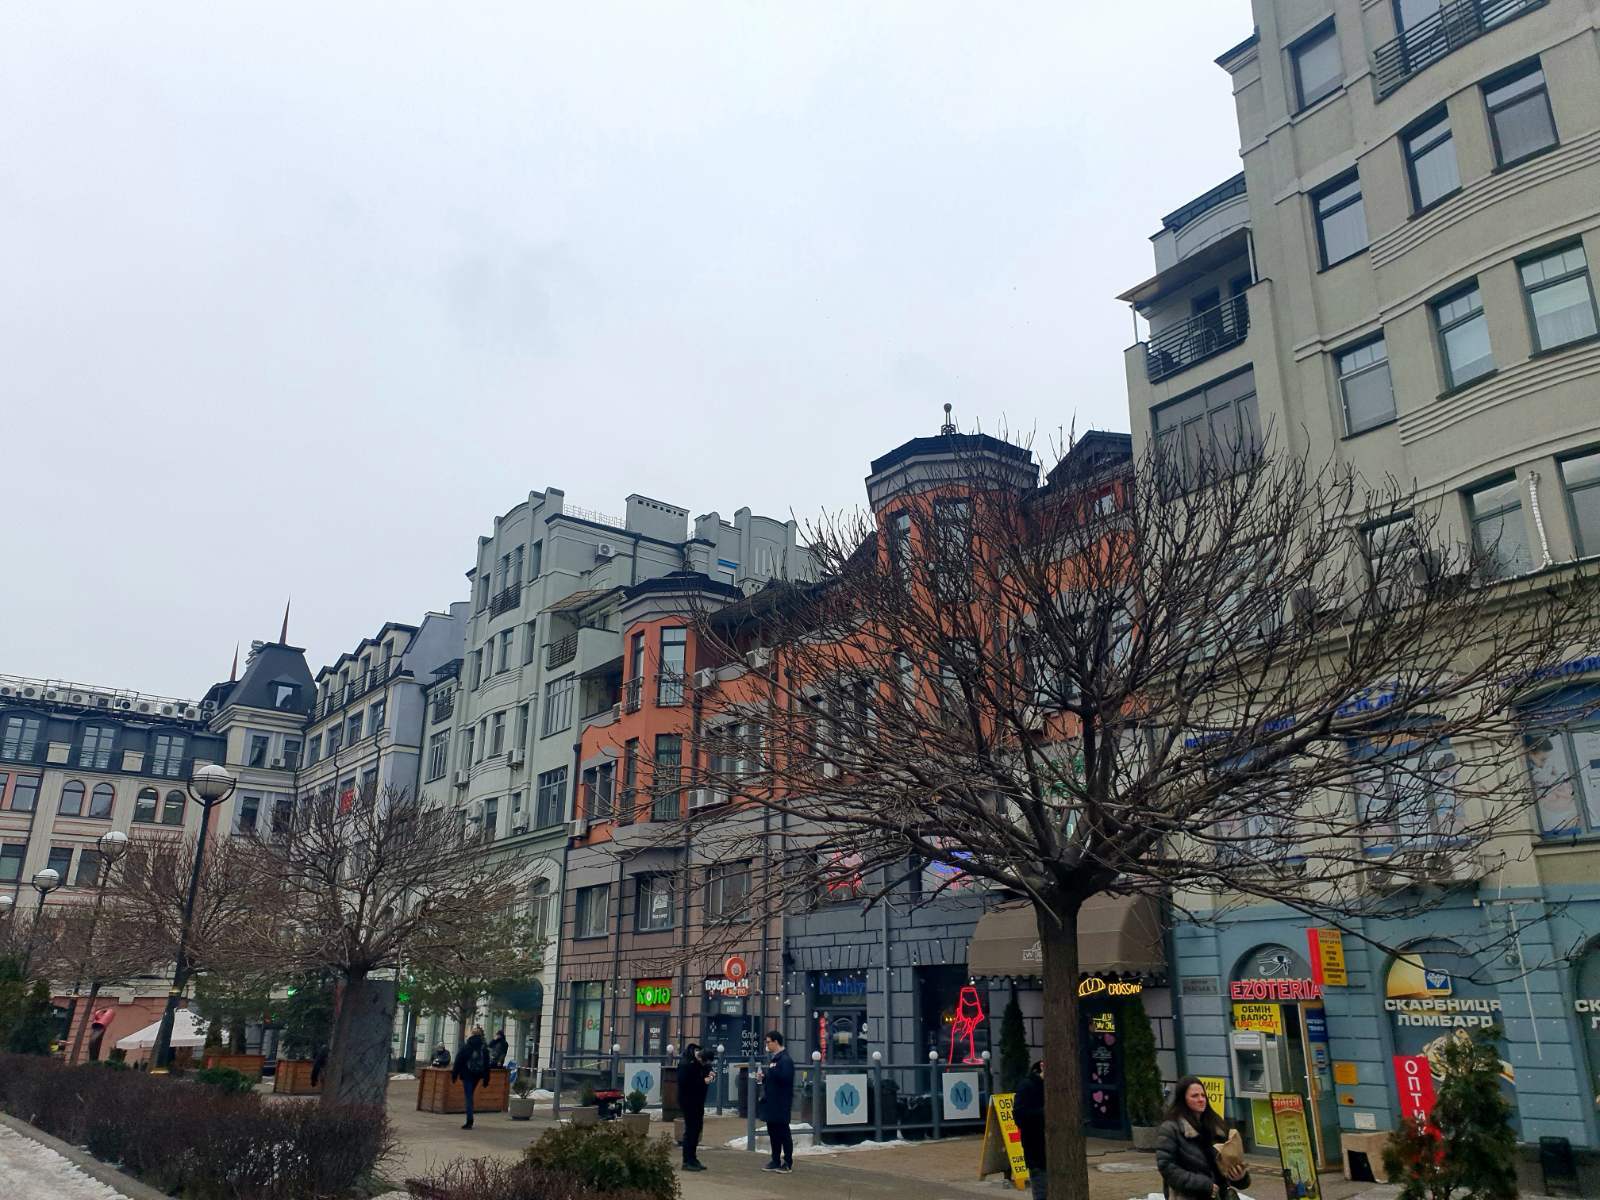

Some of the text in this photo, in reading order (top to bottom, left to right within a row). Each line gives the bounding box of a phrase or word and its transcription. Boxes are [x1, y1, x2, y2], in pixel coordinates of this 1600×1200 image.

[636, 986, 671, 1006] КОЛО
[1230, 979, 1324, 1000] EZOTERIA
[1241, 1005, 1272, 1013] ОБМІН
[1385, 999, 1502, 1013] СКАРБНИЦЯ
[1240, 1013, 1274, 1022] ВАЛЮТ
[1398, 1014, 1494, 1028] ЛОМБАРД
[636, 1076, 649, 1088] M
[1204, 1081, 1220, 1092] МІН
[839, 1091, 854, 1107] M
[954, 1087, 967, 1102] M
[999, 1098, 1013, 1109] ОБ
